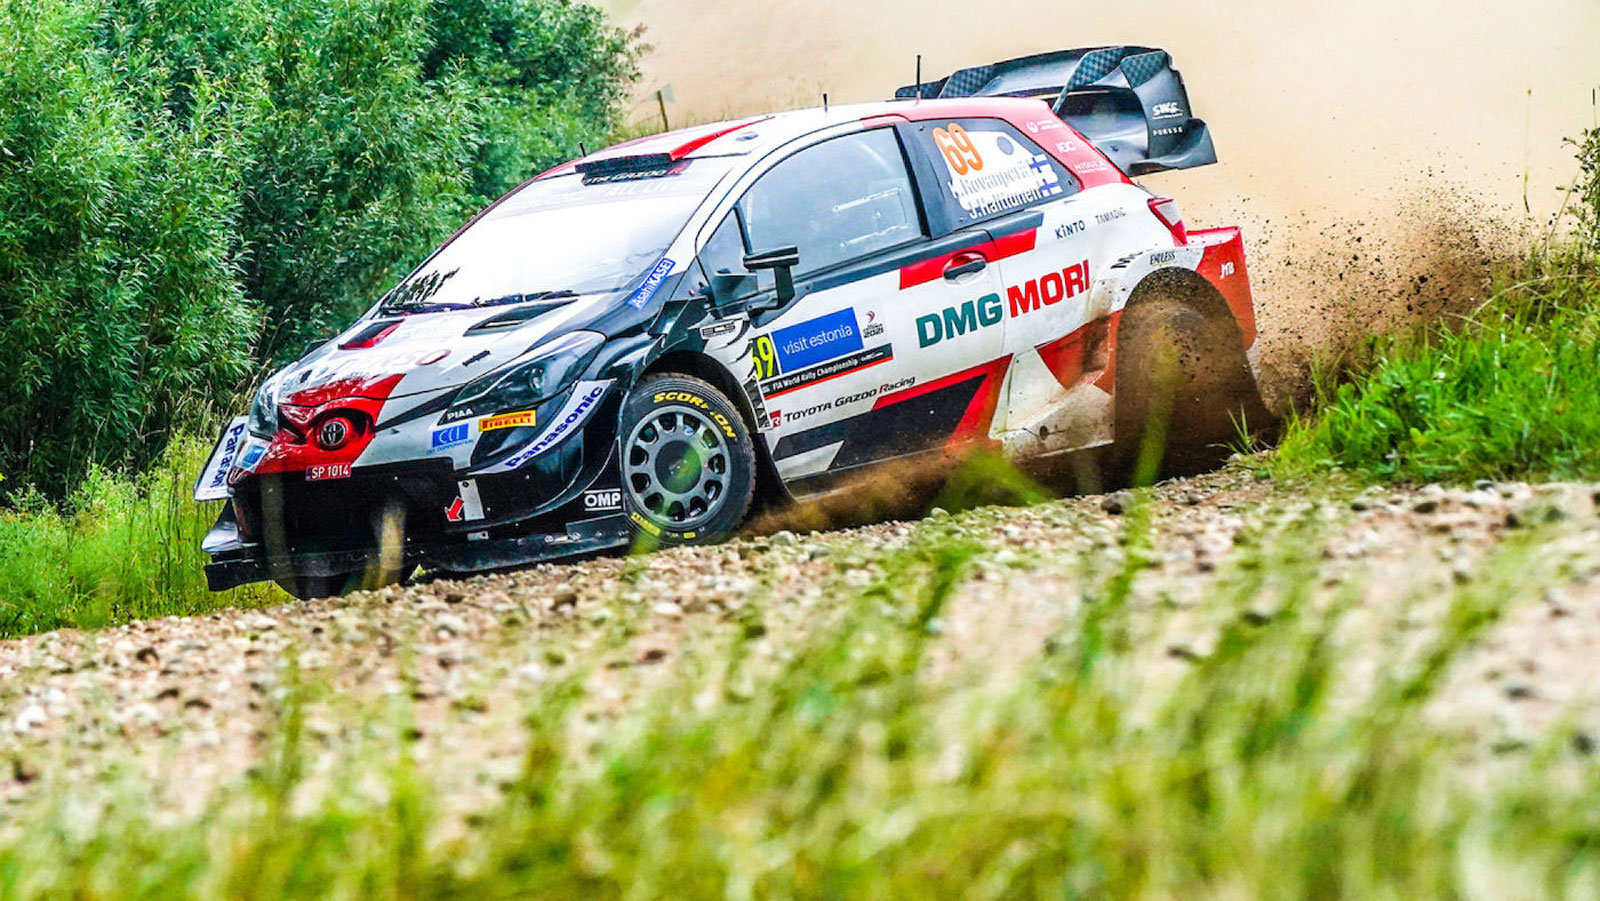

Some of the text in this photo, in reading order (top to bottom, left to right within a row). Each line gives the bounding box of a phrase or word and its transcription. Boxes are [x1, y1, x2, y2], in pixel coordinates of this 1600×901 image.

[932, 123, 983, 175] 69
[1095, 207, 1127, 224] TAMADIC
[1150, 250, 1175, 264] ENDLESS
[916, 260, 1089, 348] DMG MORI
[783, 337, 809, 355] visit
[811, 324, 853, 347] estonia
[783, 375, 800, 387] World
[801, 371, 816, 383] Rally
[817, 358, 859, 377] Championship
[784, 402, 831, 423] TOYOTA
[835, 389, 877, 407] GAZOO
[879, 377, 915, 393] Racing
[447, 408, 473, 420] PIAA
[482, 413, 532, 429] PIRELLI
[504, 386, 603, 467] Panasonic
[312, 465, 349, 479] SP 1014
[585, 492, 621, 508] OMP
